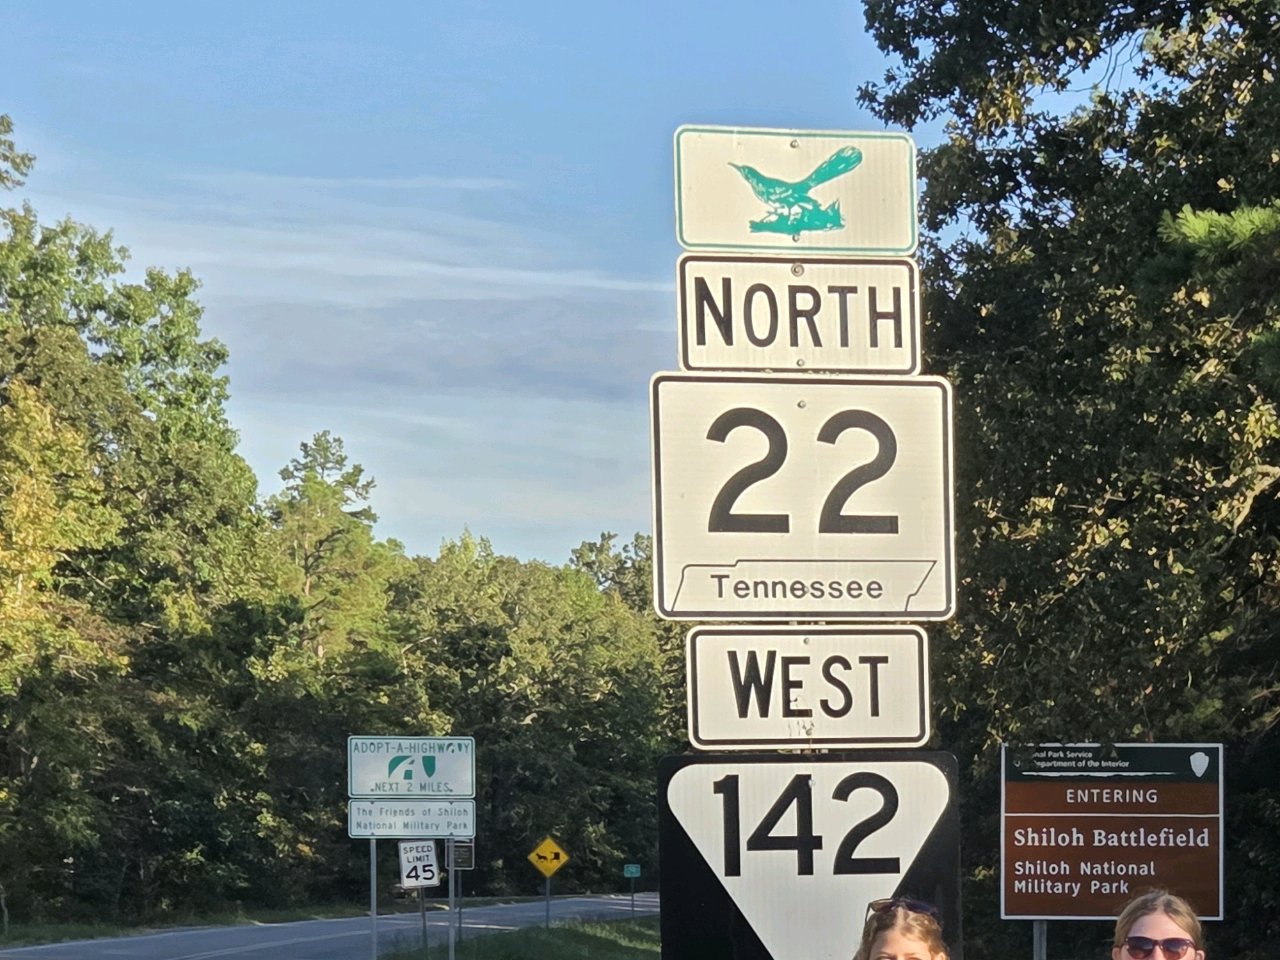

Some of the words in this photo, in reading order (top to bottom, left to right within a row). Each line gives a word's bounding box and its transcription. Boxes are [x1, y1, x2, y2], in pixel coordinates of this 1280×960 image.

[695, 276, 903, 348] NORTH
[706, 407, 899, 534] 22
[710, 574, 884, 600] Tennessee
[727, 650, 889, 718] WEST
[1078, 760, 1086, 768] of
[1087, 760, 1099, 768] the
[1101, 760, 1129, 768] Interior
[374, 782, 399, 792] NEXT
[407, 782, 413, 792] 2
[420, 782, 449, 792] MILES
[1066, 789, 1158, 803] ENTERING
[357, 808, 372, 817] The
[379, 807, 416, 817] Friends
[422, 807, 431, 817] of
[437, 807, 468, 817] Shiloh
[356, 821, 397, 830] National
[403, 821, 440, 831] Military
[447, 821, 468, 830] Park
[713, 771, 901, 877] 142
[1013, 827, 1085, 847] Shiloh
[1093, 827, 1209, 847] Battlefield
[403, 845, 433, 854] SPEED
[407, 855, 430, 863] LIMIT
[406, 864, 435, 881] 45
[1014, 861, 1070, 875] Shiloh
[1080, 861, 1156, 875] National
[1014, 880, 1081, 897] Military
[1090, 880, 1129, 893] Park
